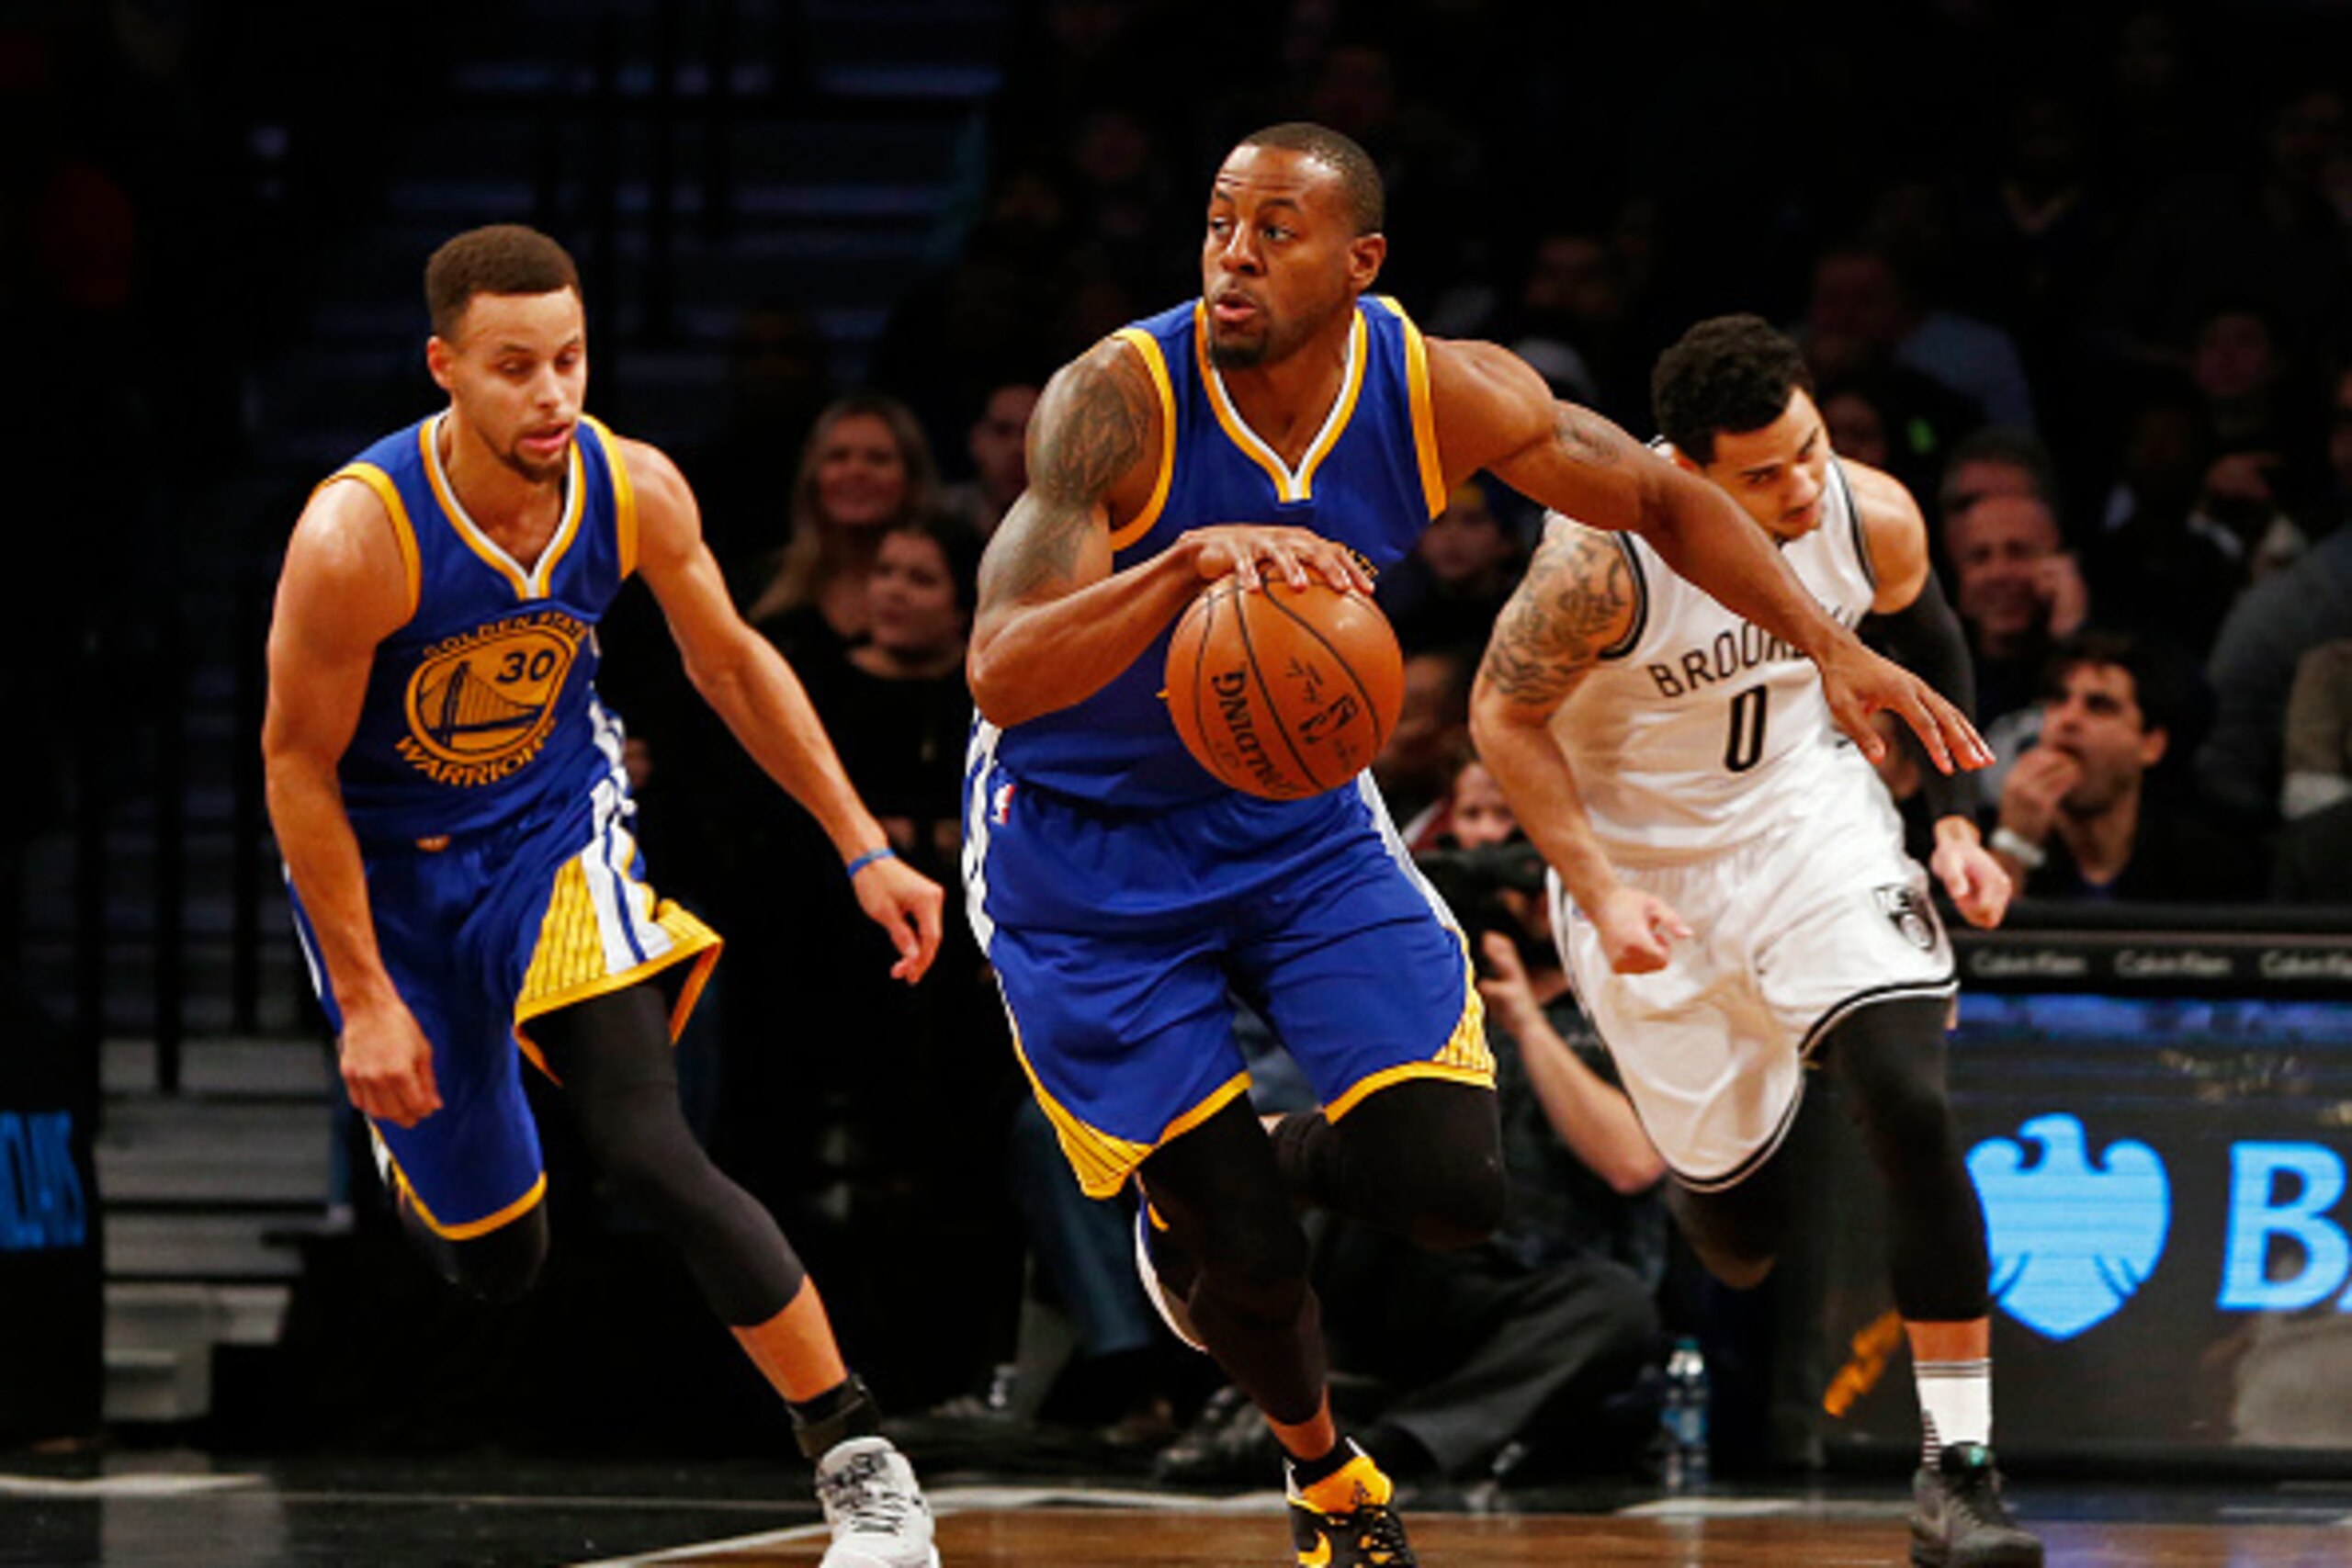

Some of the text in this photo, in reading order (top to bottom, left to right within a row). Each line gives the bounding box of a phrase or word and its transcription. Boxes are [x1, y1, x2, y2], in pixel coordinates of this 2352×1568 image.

[423, 616, 530, 660] GOLDEN
[495, 648, 556, 685] 30
[1647, 606, 1854, 698] BROOK
[395, 716, 556, 787] WARRIO
[1724, 683, 1767, 773] 0
[2216, 1139, 2352, 1312] B
